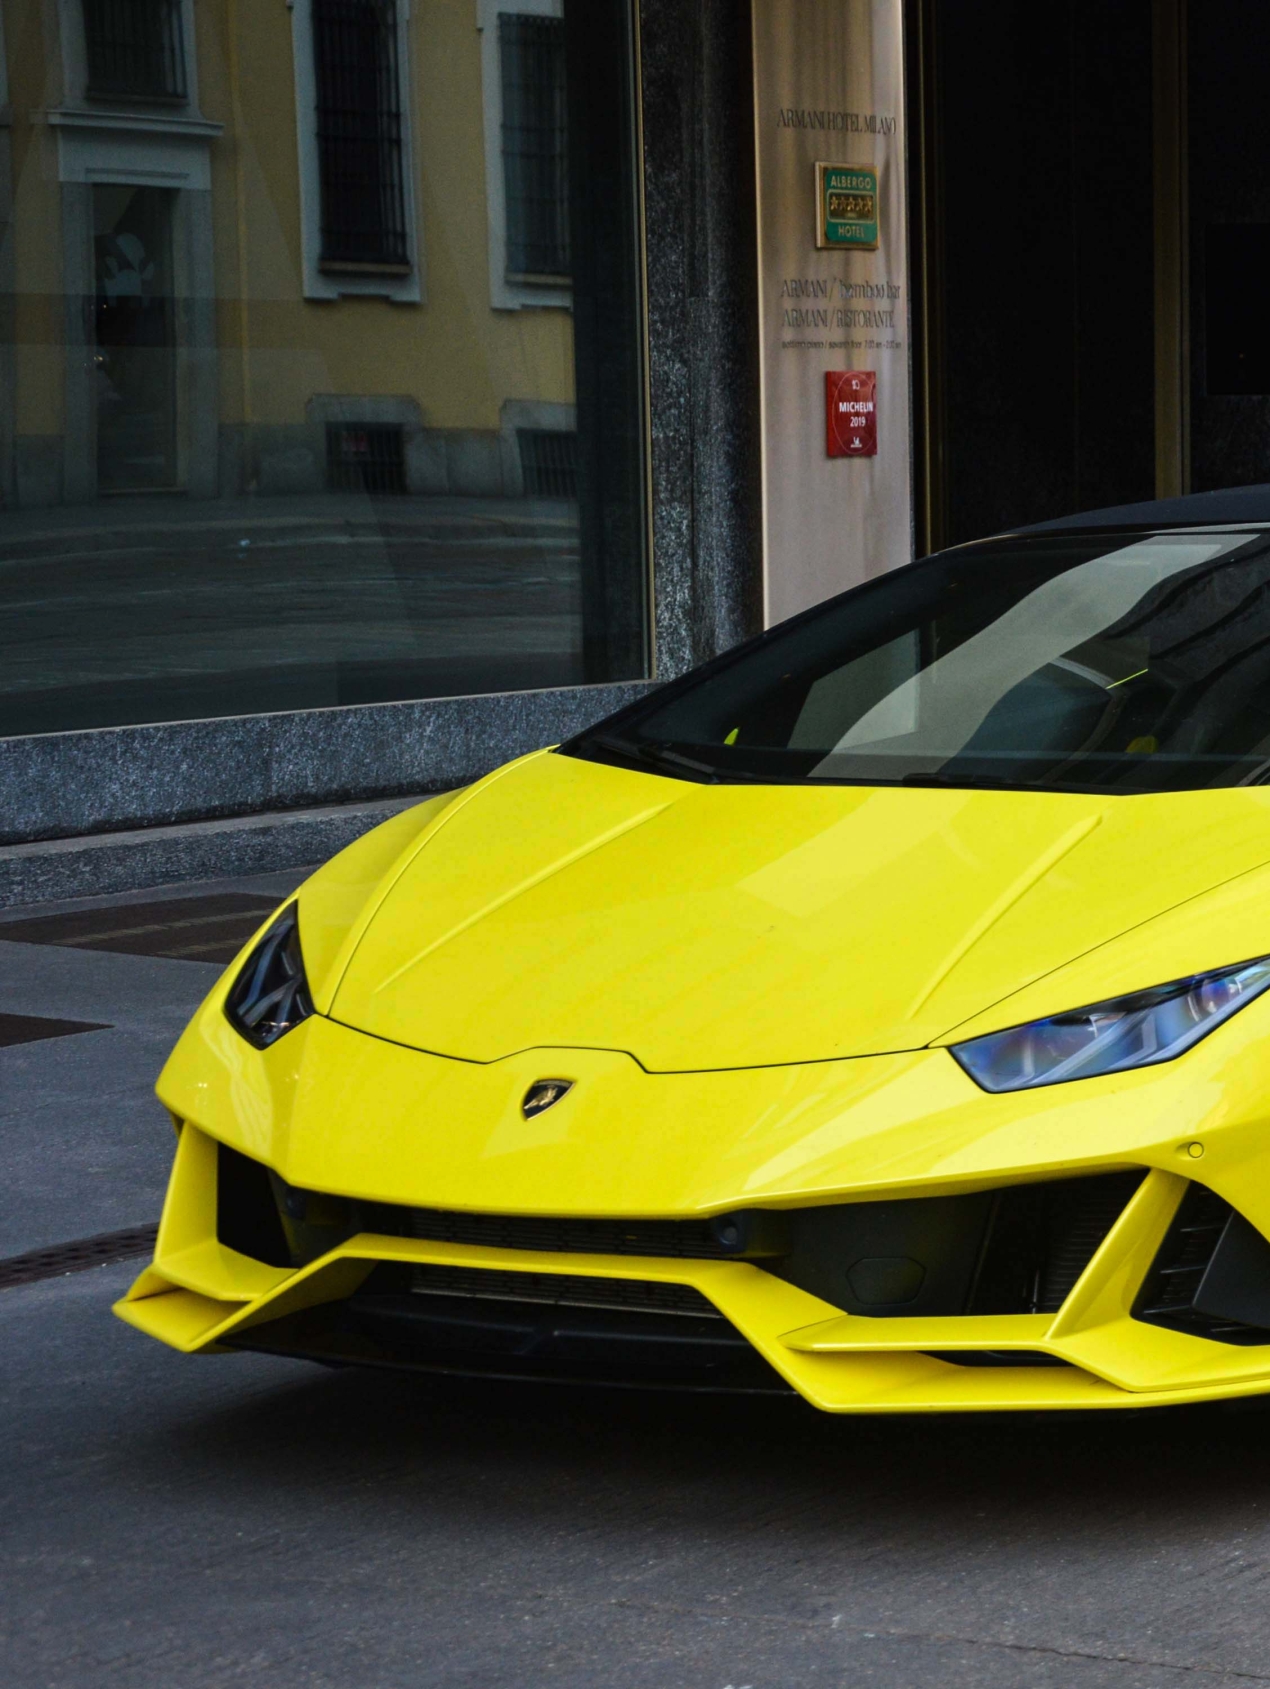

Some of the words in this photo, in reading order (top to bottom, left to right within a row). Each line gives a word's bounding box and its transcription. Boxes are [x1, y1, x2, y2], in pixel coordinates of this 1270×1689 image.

[777, 108, 825, 130] ARMANI
[827, 111, 862, 133] HOTEL
[830, 175, 872, 189] ALBERGO
[838, 225, 865, 238] HOTEL
[781, 279, 827, 299] ARMANI
[781, 308, 828, 328] ARMANI
[836, 309, 895, 329] RISTORANTE
[839, 401, 874, 413] MICHELIN
[850, 416, 866, 427] 2019
